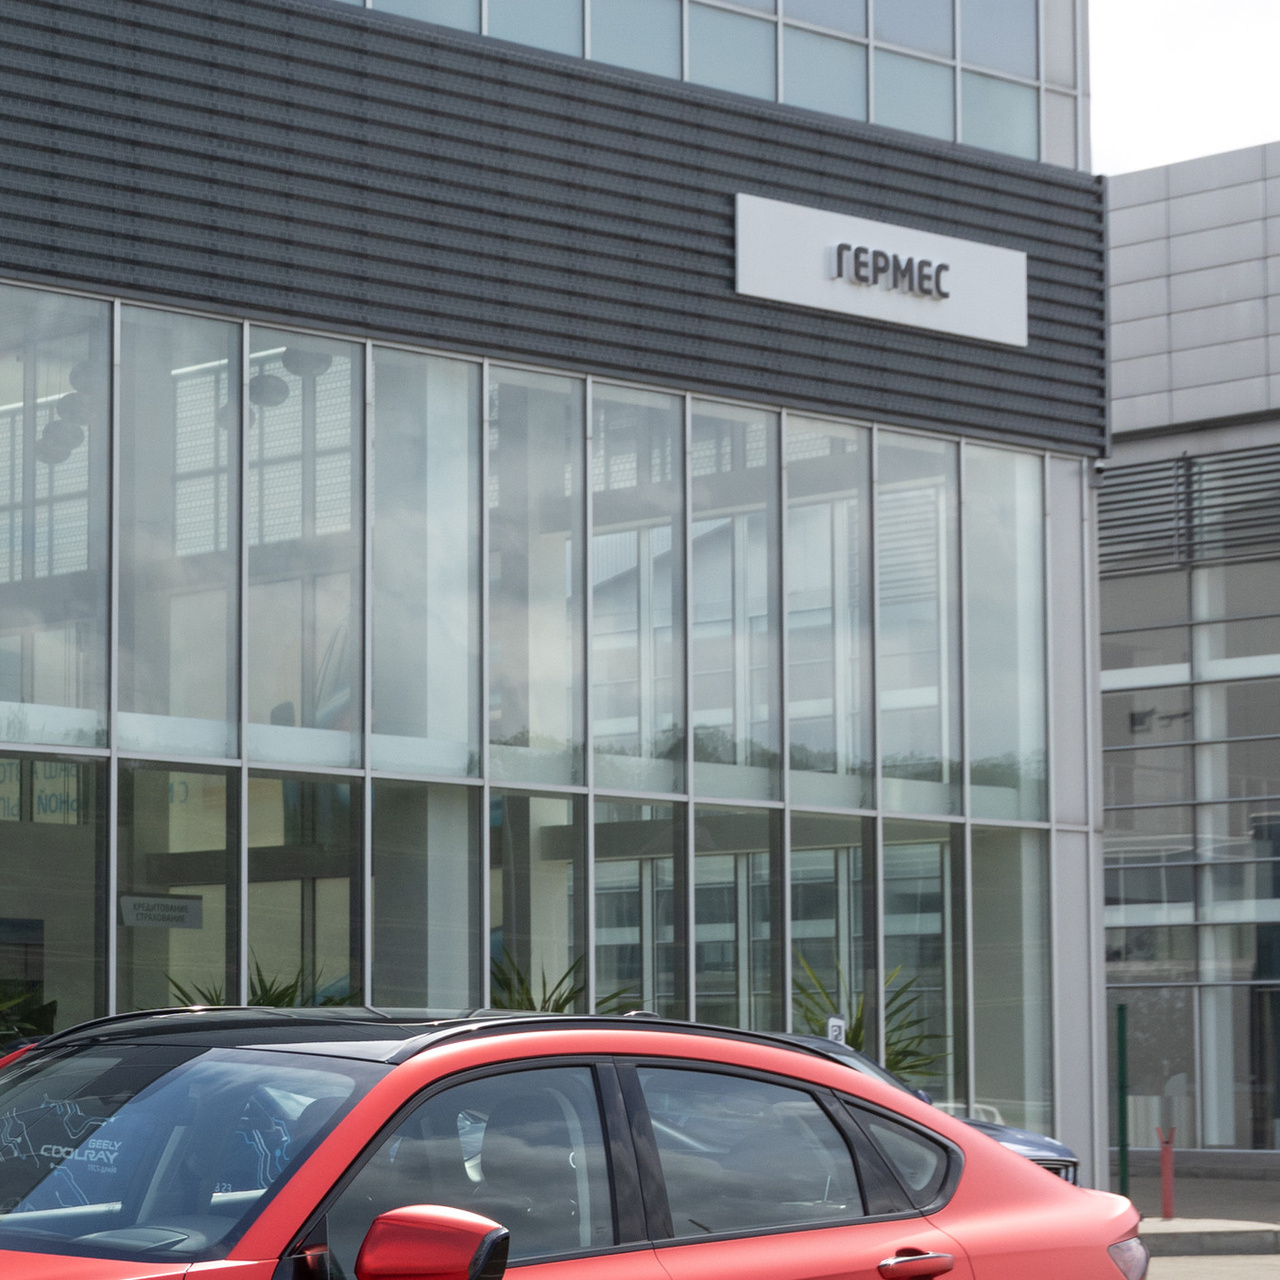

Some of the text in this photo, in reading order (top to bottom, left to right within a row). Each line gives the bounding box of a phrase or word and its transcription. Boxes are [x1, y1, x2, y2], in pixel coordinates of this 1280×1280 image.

[835, 242, 950, 299] ГЕРМЕС
[40, 1144, 119, 1164] COOLRAY
[88, 1139, 122, 1150] GEELY
